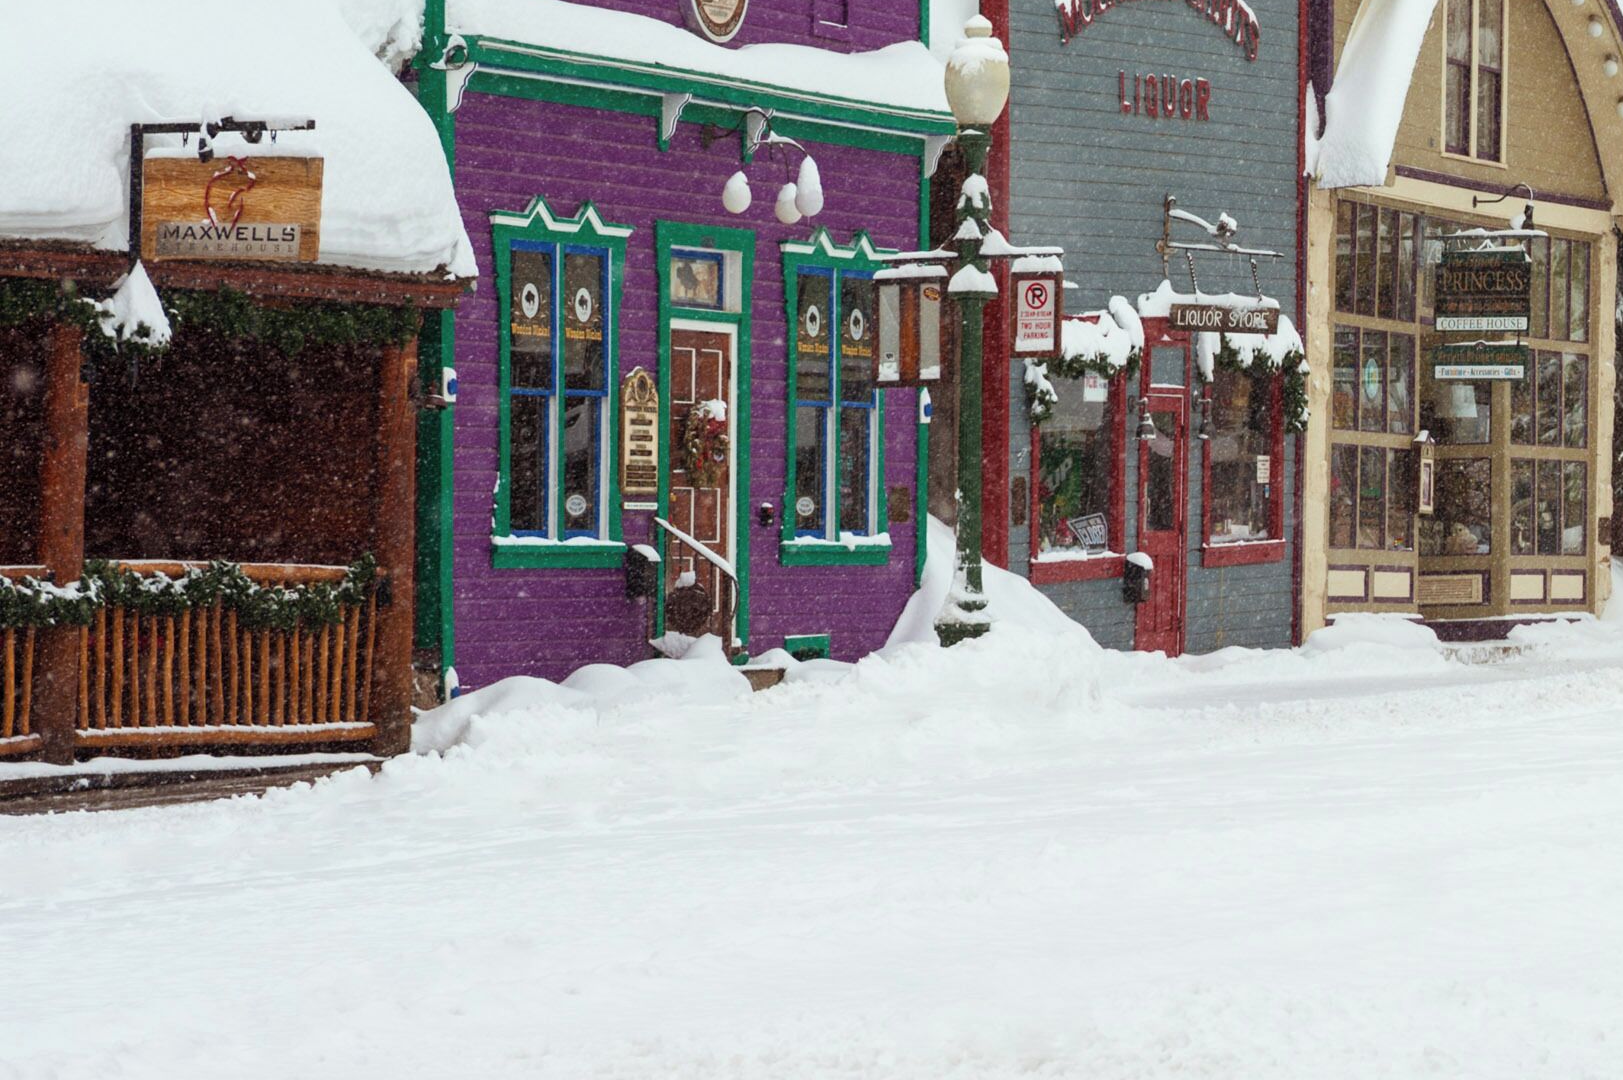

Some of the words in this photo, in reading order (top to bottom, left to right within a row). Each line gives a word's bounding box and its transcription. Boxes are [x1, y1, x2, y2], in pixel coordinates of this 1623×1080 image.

[1118, 70, 1212, 121] LIQUOR
[162, 225, 296, 242] MAXWELLS
[161, 242, 295, 253] STEAKHOUSE
[1443, 270, 1525, 291] PRINCESS
[1177, 309, 1222, 327] LIQUOR
[1035, 322, 1051, 330] HOUR
[1441, 319, 1483, 330] COFFEE
[1486, 319, 1523, 329] HOUSE
[1023, 331, 1048, 339] PARKING
[1440, 367, 1466, 377] Furniture
[1470, 367, 1500, 376] Accessories
[1503, 366, 1517, 376] Gifts
